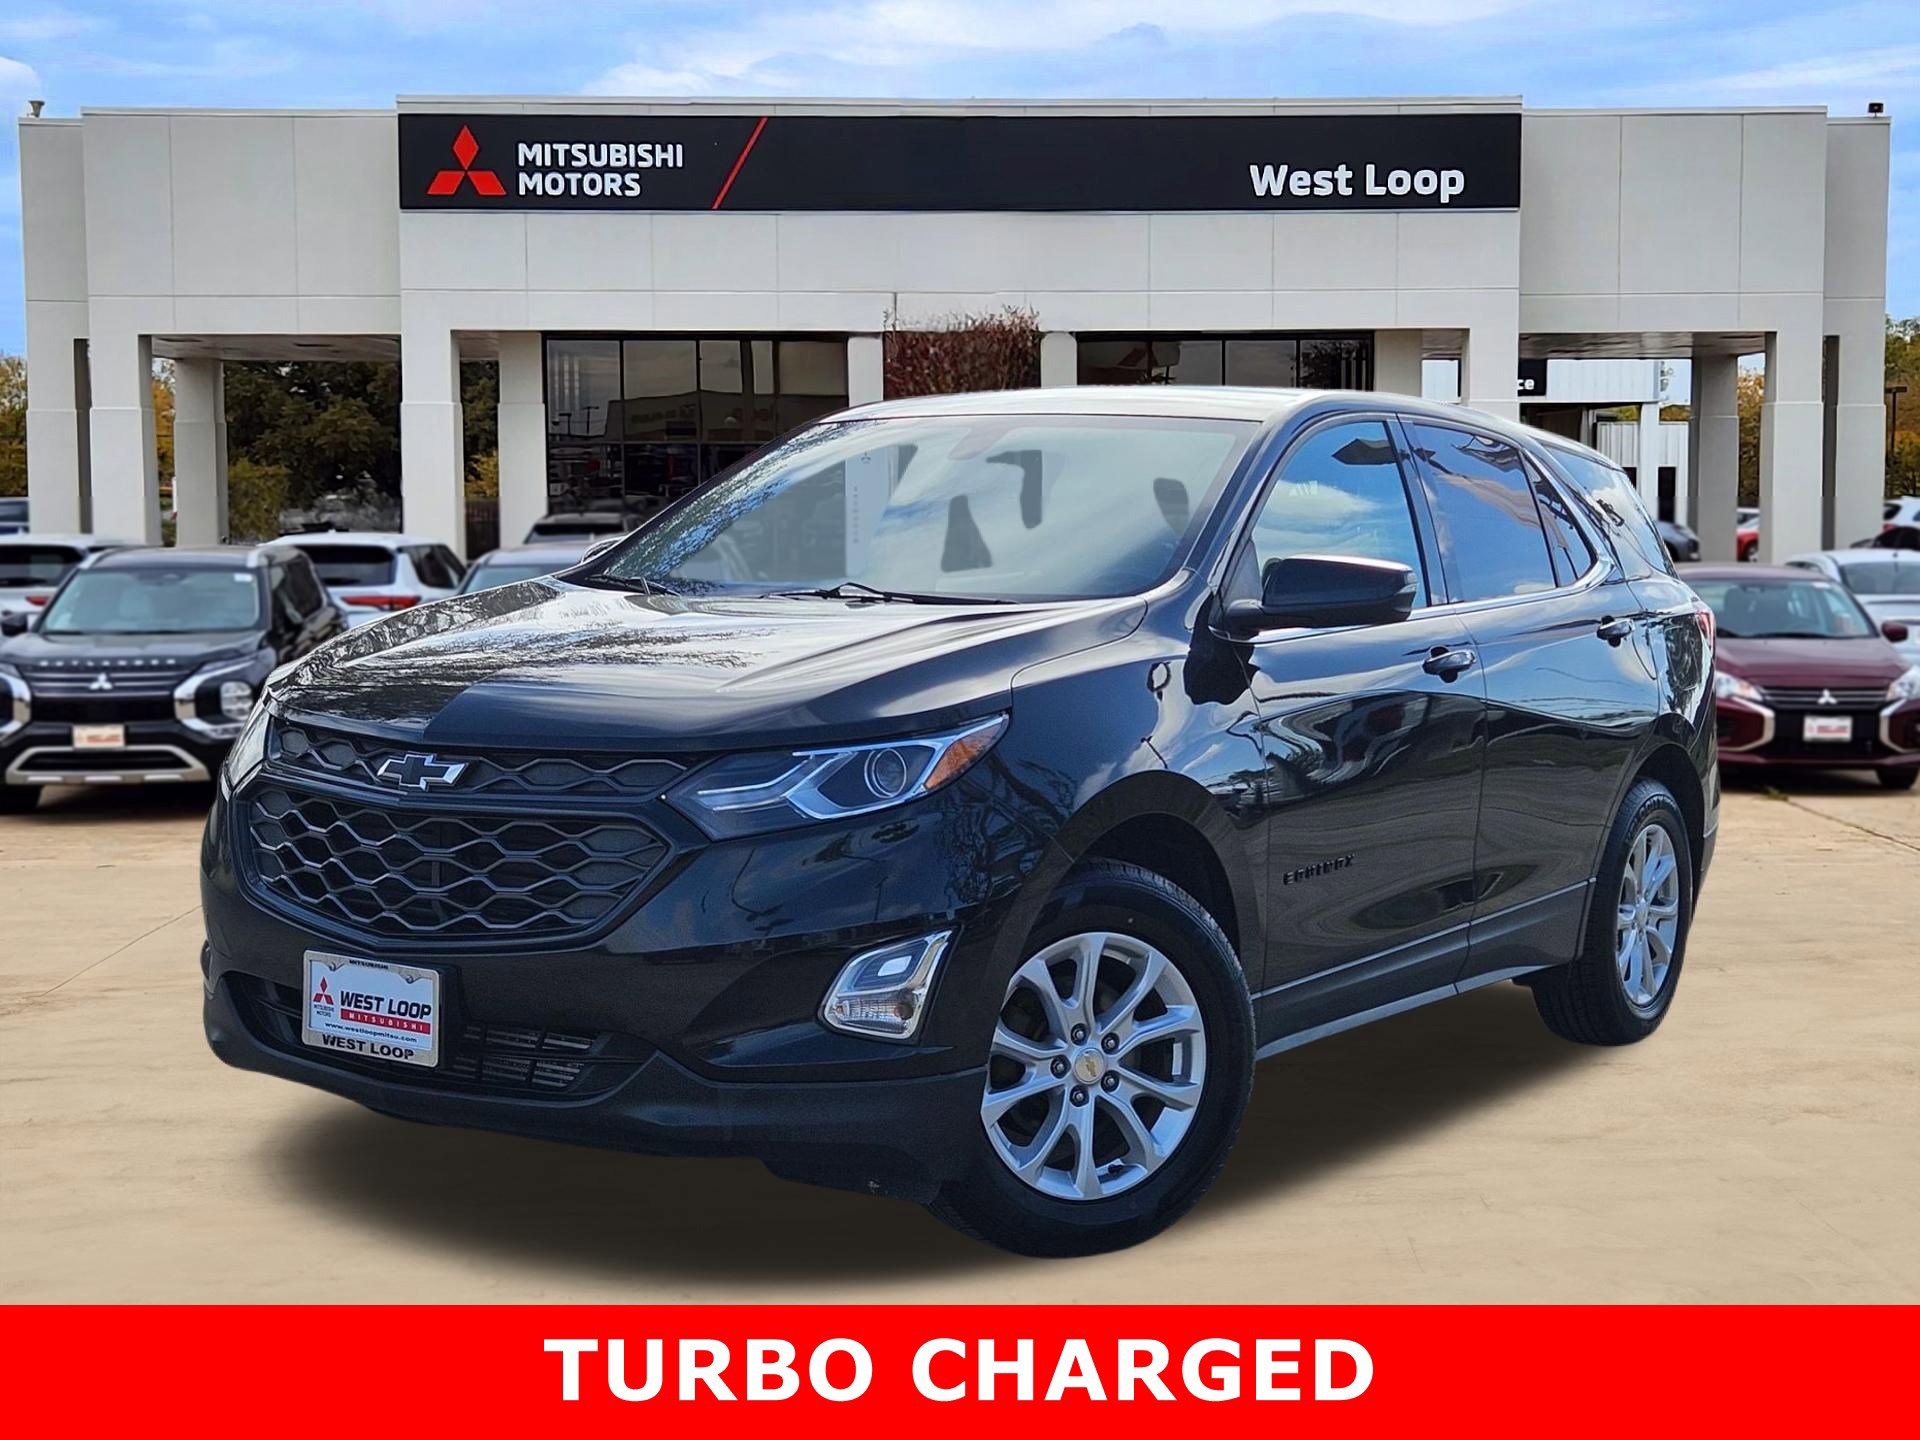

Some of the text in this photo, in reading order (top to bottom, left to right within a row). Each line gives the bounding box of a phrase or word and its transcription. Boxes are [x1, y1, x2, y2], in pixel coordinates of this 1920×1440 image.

[518, 143, 683, 168] MITSUBISHI
[518, 172, 641, 197] MOTORS
[1250, 164, 1465, 204] West Loop
[340, 990, 432, 1020] WEST LOOP
[348, 1012, 423, 1031] MITSUBISHI
[322, 1034, 414, 1060] WEST LOOP
